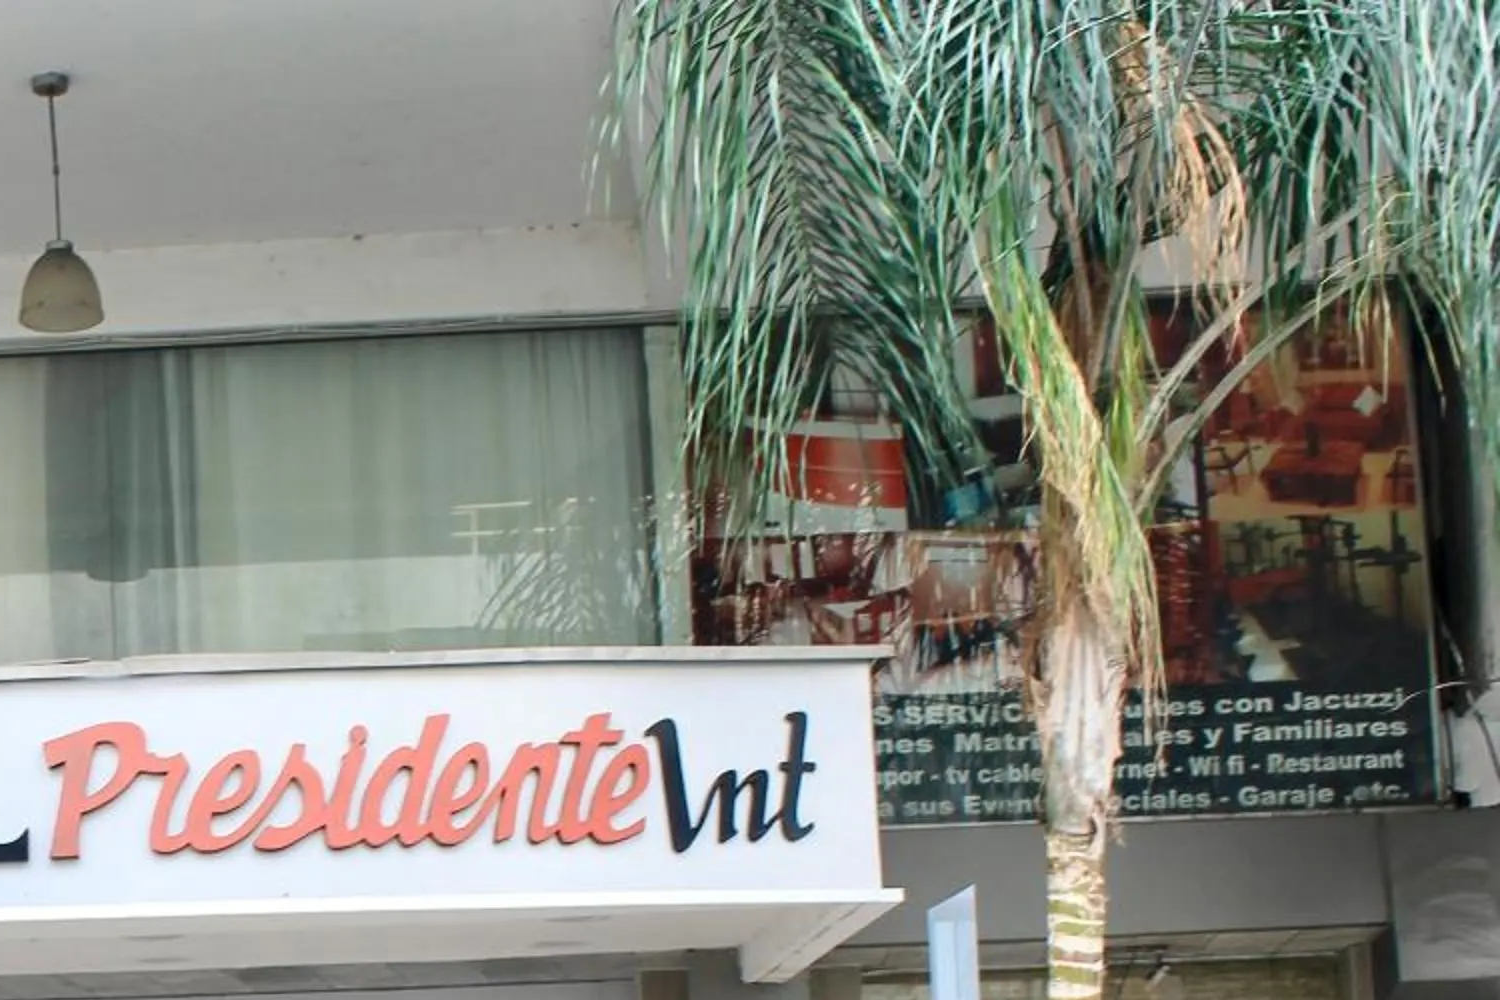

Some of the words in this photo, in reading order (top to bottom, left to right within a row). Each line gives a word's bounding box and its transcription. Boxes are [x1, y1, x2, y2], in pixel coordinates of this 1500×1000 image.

[1214, 696, 1274, 714] con
[1283, 688, 1405, 712] Jacuzzi
[876, 736, 934, 754] nes
[1202, 727, 1224, 749] y
[1232, 719, 1409, 743] Familiares
[945, 766, 971, 785] tv
[977, 763, 1045, 785] cable
[1188, 754, 1221, 777] Wi
[1226, 753, 1245, 776] fi
[1267, 749, 1405, 774] Restaurant
[43, 712, 652, 861] Presidente
[903, 799, 956, 817] sus
[1238, 783, 1335, 808] Garaje
